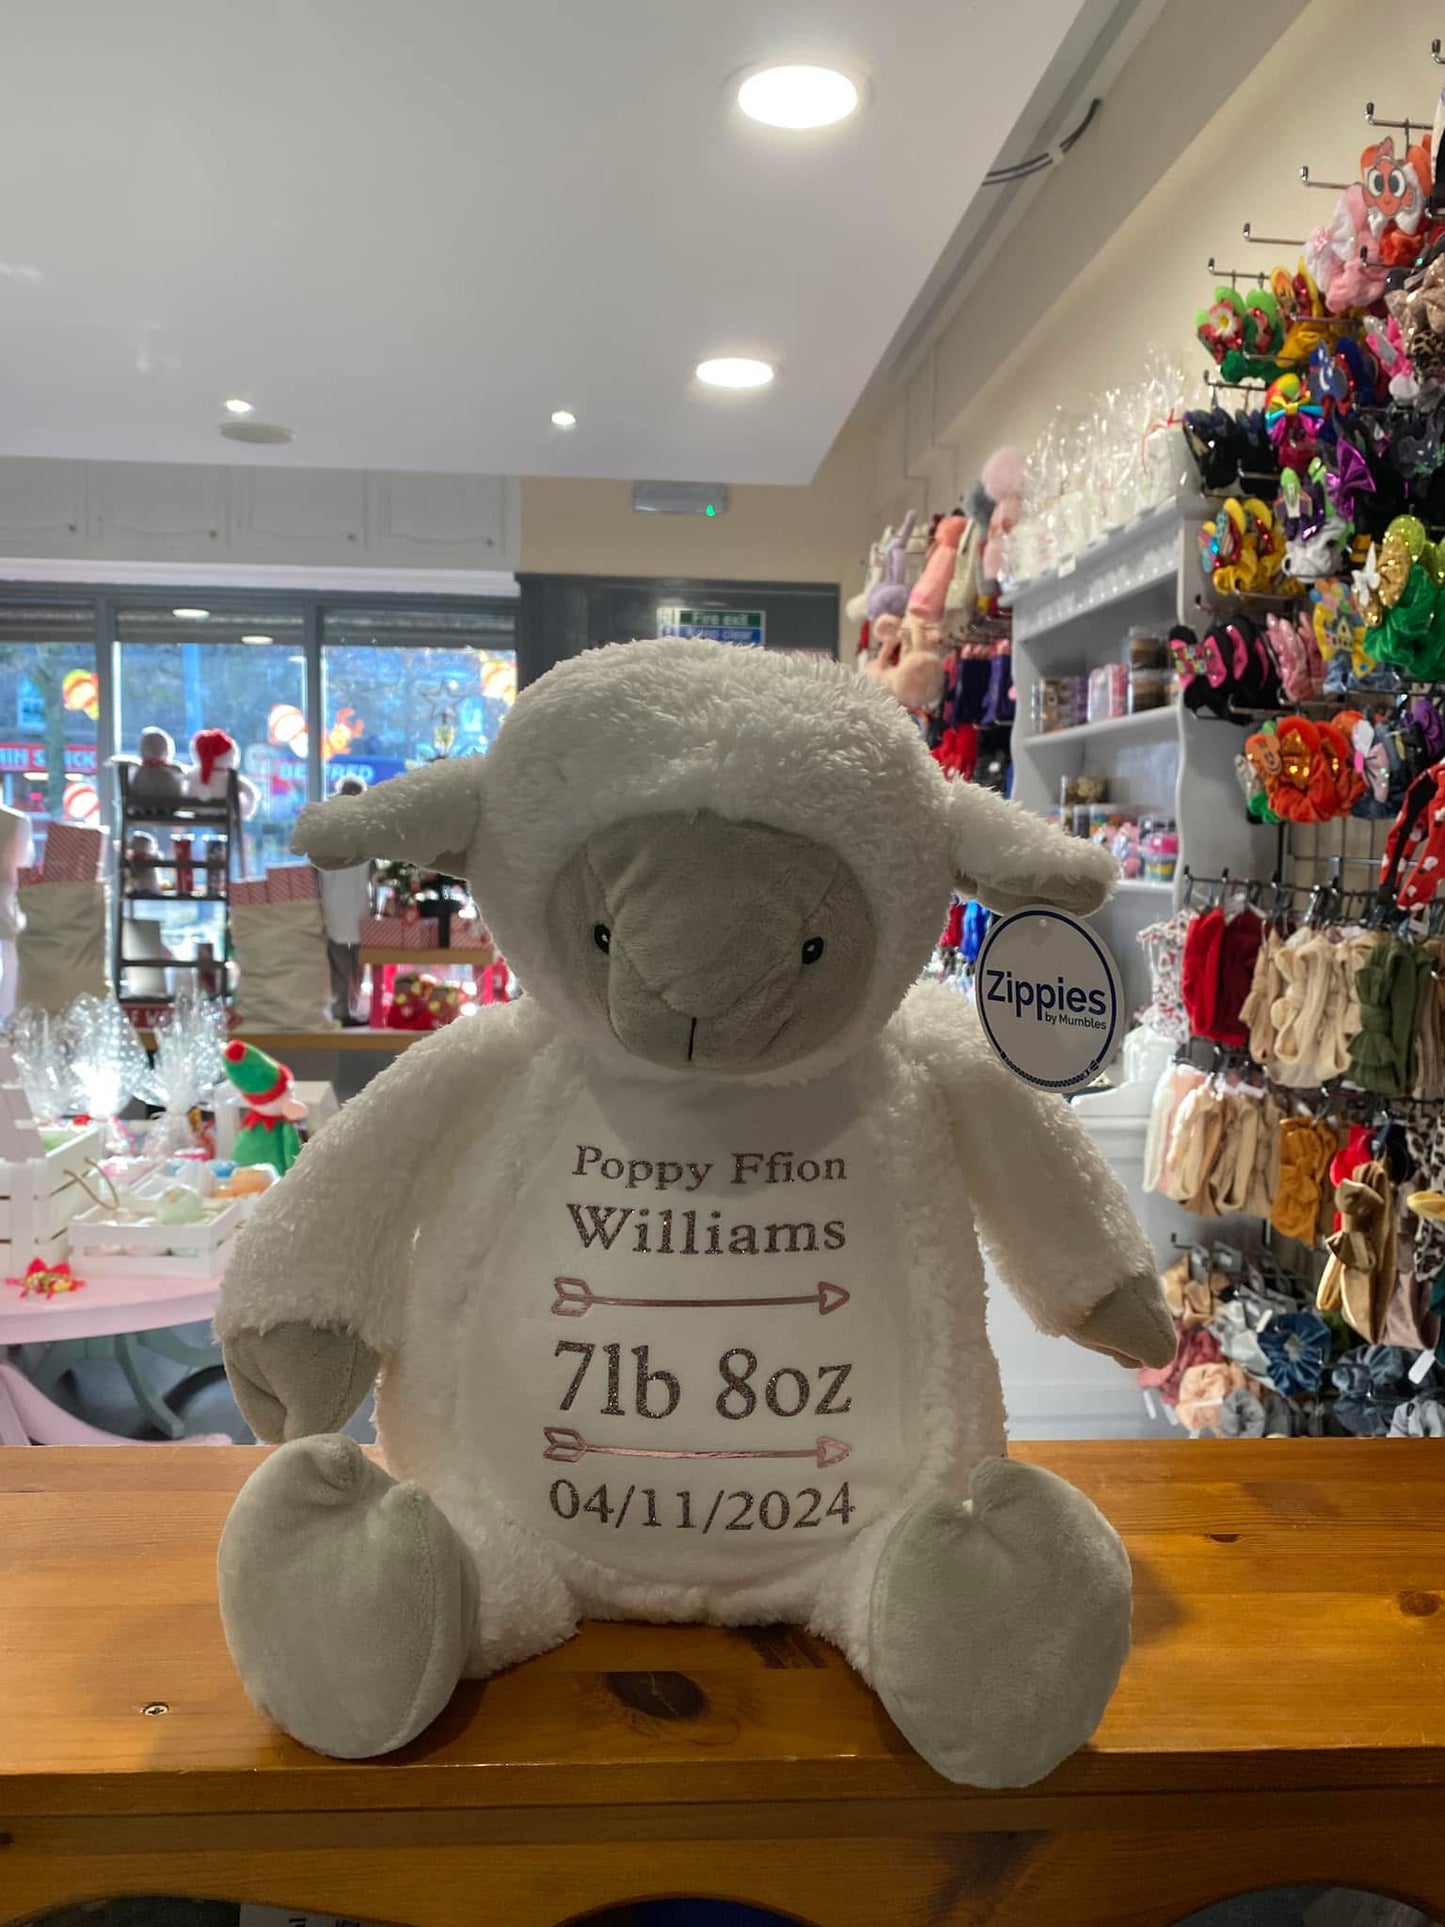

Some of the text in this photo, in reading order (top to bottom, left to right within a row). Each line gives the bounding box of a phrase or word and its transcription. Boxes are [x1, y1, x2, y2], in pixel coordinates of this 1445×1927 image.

[986, 969, 1107, 1021] Zippies
[1045, 1012, 1107, 1030] by Mumbles
[572, 1145, 848, 1192] Poppy Ffion
[566, 1203, 847, 1255] Williams
[554, 1340, 854, 1420] 7lb 8oz
[549, 1478, 857, 1534] 04/11/2024
